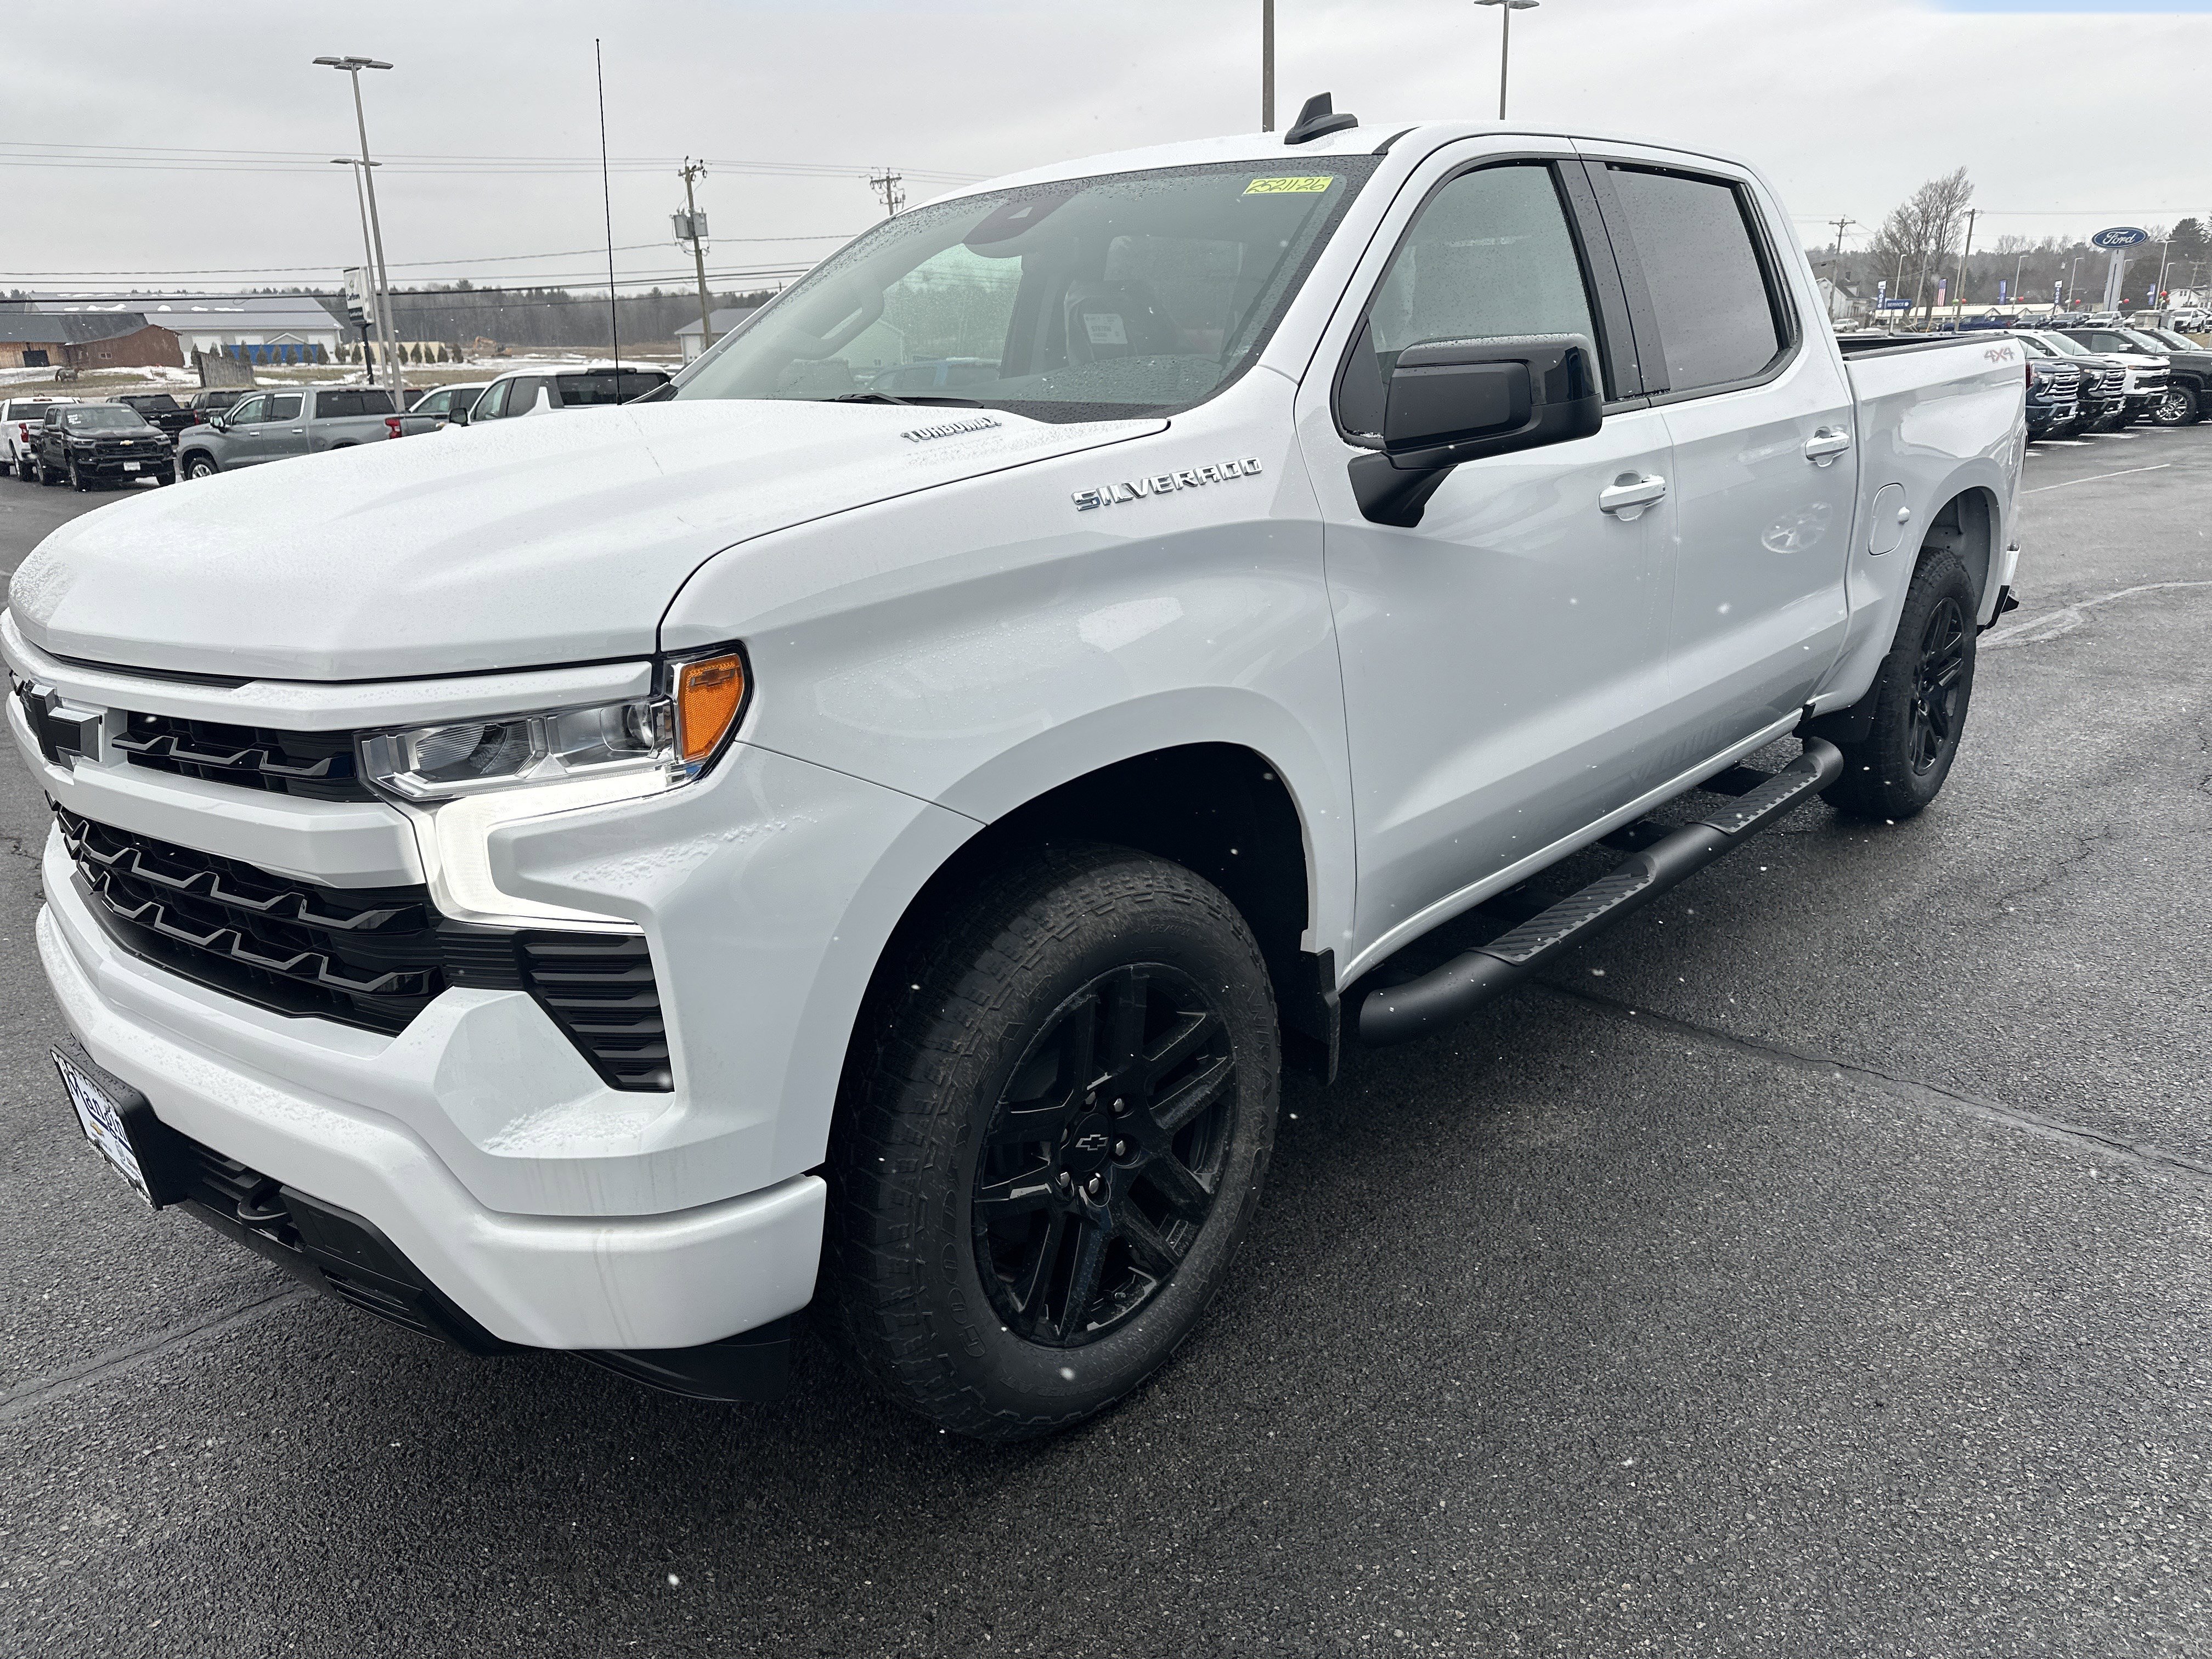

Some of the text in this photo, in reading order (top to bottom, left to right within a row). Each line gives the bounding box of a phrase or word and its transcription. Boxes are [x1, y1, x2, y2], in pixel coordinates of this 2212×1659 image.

[2102, 231, 2137, 245] Ford
[900, 415, 1002, 443] TURBOMAX
[1072, 456, 1263, 511] SILVERADO
[939, 971, 1057, 1363] GOODYEAR
